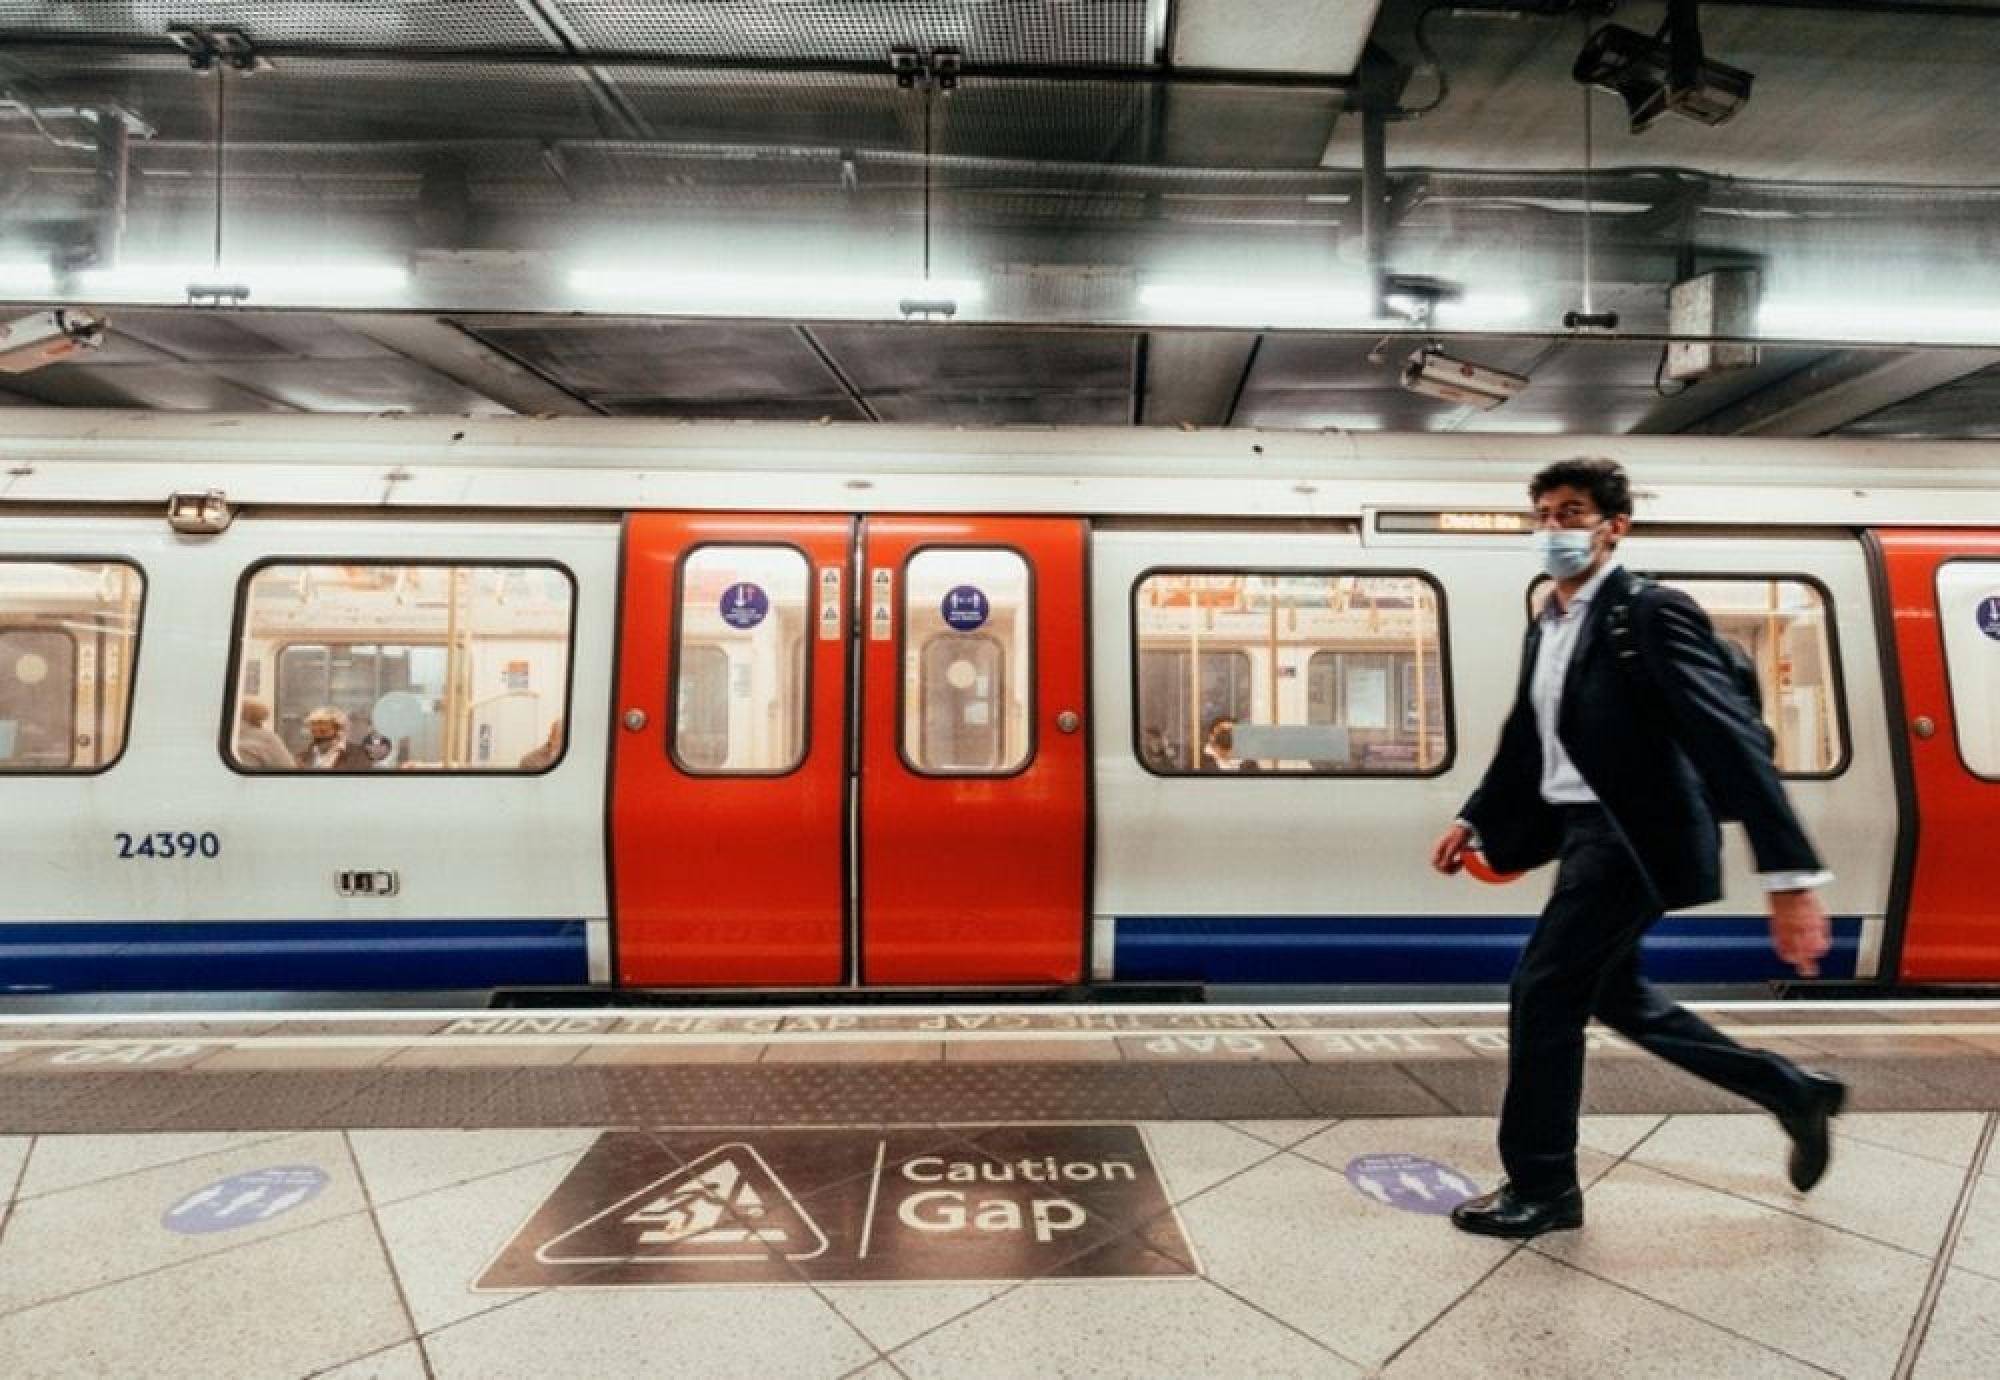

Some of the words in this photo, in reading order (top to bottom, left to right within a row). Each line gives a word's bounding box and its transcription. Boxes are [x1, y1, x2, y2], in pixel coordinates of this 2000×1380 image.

[114, 831, 221, 858] 24390
[446, 1017, 601, 1034] MIND
[1144, 1035, 1264, 1053] GAP
[901, 1155, 1136, 1182] Caution
[898, 1190, 1088, 1241] Gap
